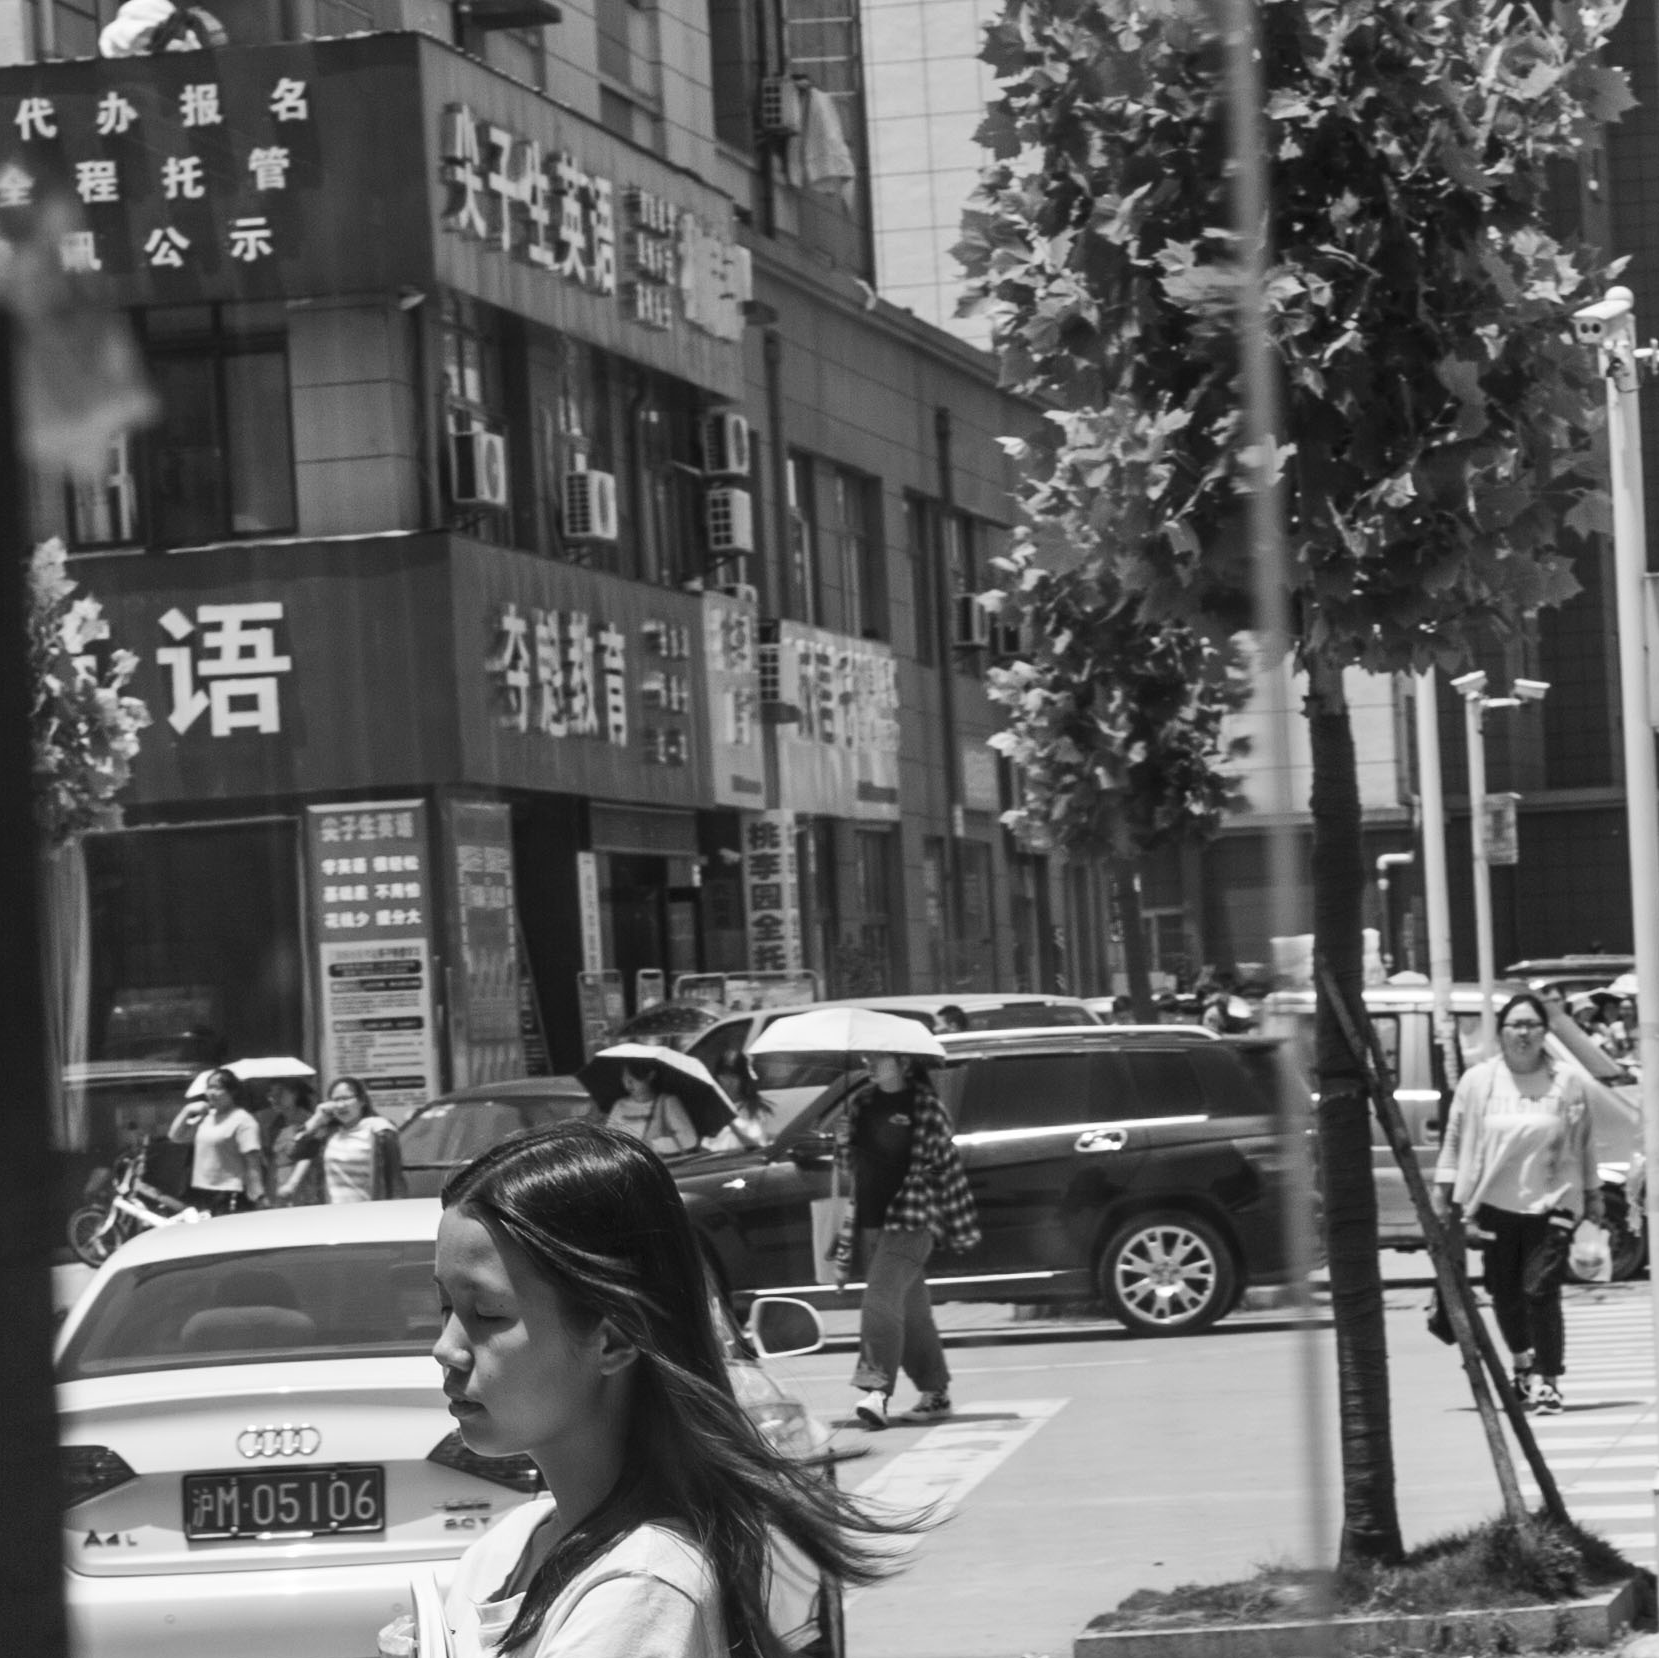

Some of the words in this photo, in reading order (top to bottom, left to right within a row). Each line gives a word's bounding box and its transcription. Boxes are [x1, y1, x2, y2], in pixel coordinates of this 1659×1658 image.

[14, 77, 310, 141] 代办报名
[117, 600, 294, 738] 语
